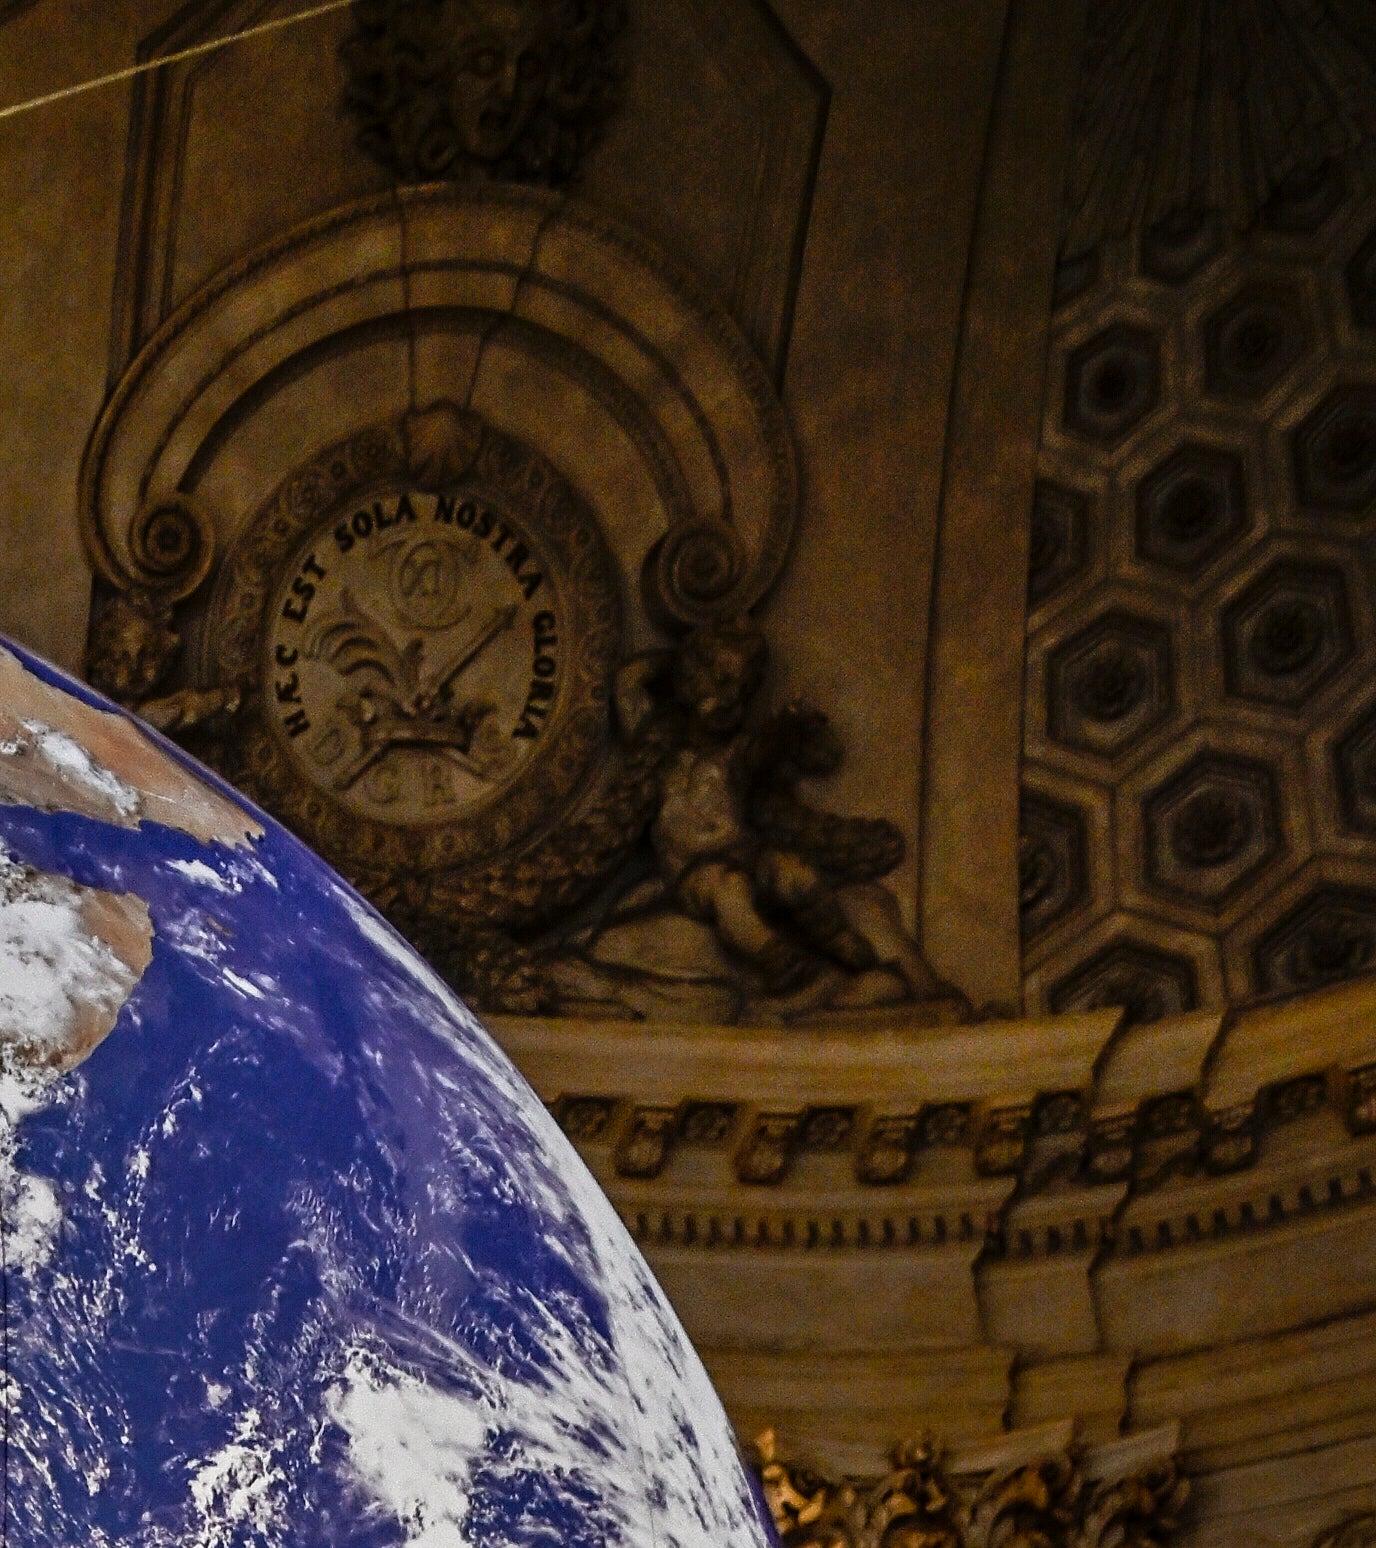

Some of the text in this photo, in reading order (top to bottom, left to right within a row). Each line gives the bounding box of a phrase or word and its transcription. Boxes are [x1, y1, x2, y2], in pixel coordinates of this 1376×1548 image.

[275, 493, 559, 739] HÆC EST SOLA NOSTRA GLORIA
